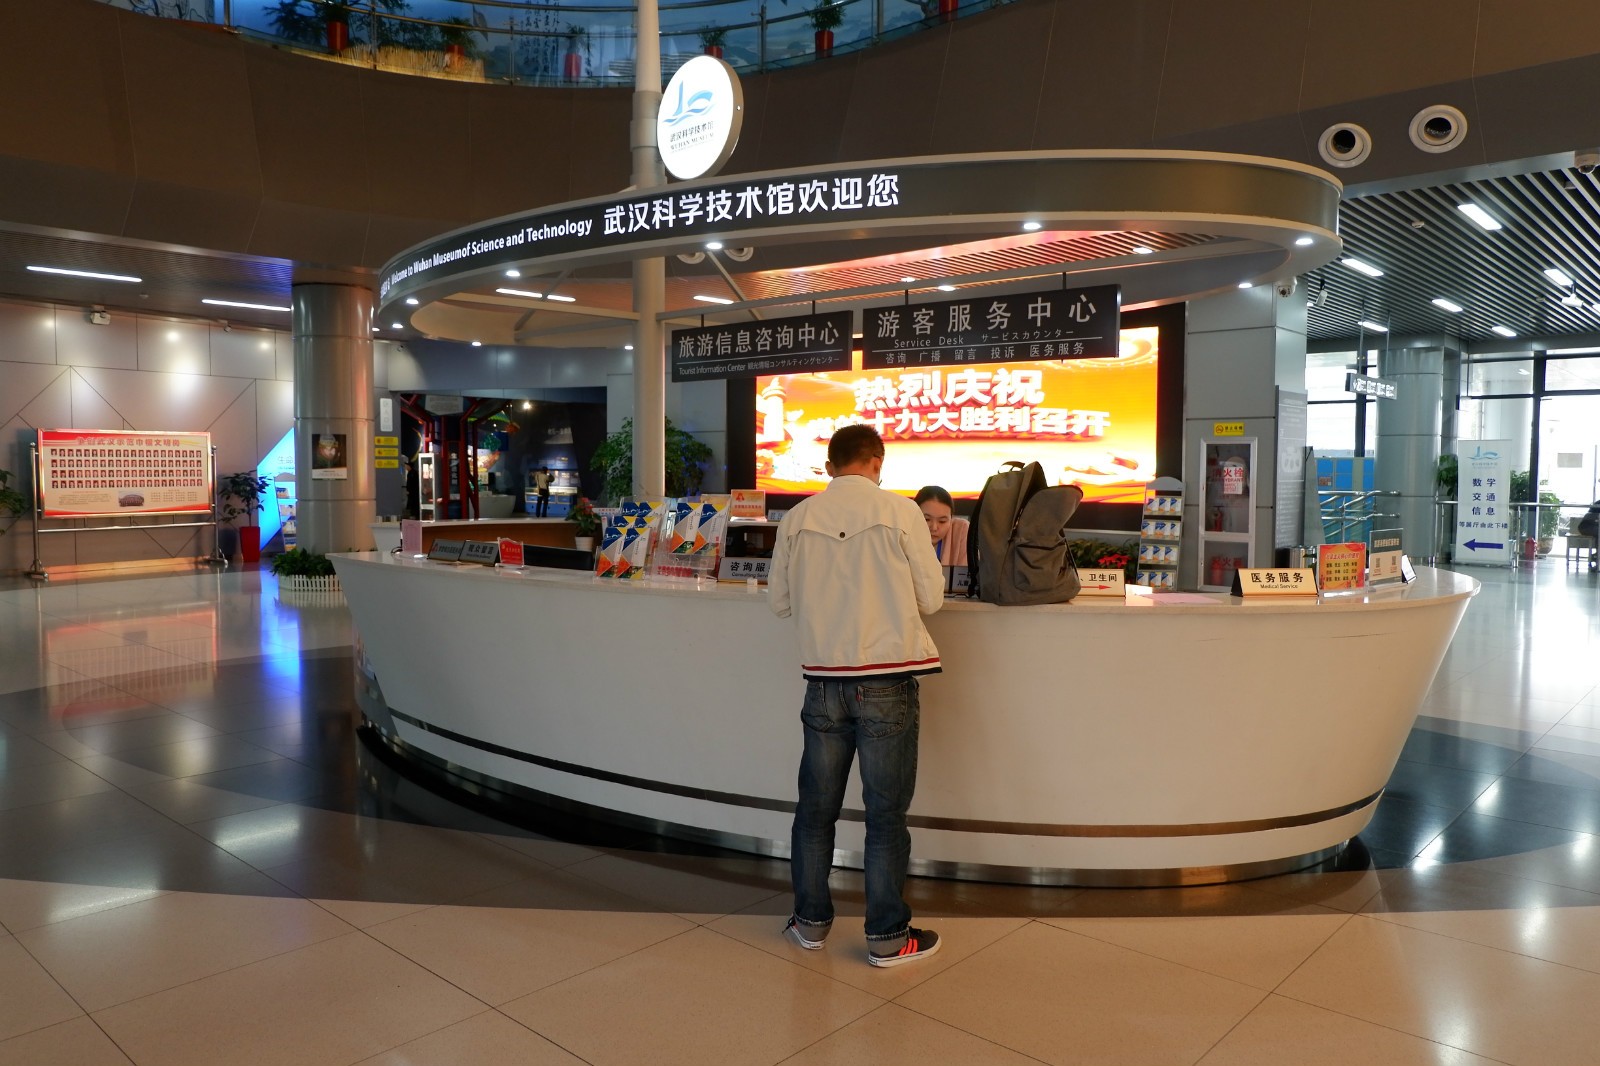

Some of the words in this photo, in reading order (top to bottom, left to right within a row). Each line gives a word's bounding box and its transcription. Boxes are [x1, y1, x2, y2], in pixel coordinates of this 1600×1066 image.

[603, 173, 899, 235] 武汉科学技术馆欢迎您
[413, 257, 432, 274] Wuhan
[472, 235, 505, 256] Science
[505, 228, 525, 247] and
[526, 219, 593, 242] Technology
[877, 294, 1097, 338] 游客服务中心
[678, 321, 840, 358] 旅游信息咨询中心
[894, 338, 931, 349] Service
[938, 335, 964, 346] Desk
[981, 330, 1075, 342] サービスカウンター
[885, 352, 906, 364] 咨询
[919, 351, 941, 363] 广播
[954, 348, 977, 360] 留言
[990, 346, 1015, 359] 投诉
[1029, 342, 1085, 357] 医务服务
[679, 366, 696, 376] Tourist
[696, 364, 727, 375] Information
[727, 363, 746, 372] Center
[854, 369, 1045, 411] 热烈庆祝
[1472, 478, 1496, 487] 数学
[1472, 492, 1496, 501] 交通
[1472, 506, 1495, 515] 信息
[730, 561, 770, 572] 咨询服
[1251, 572, 1304, 583] 医务服务
